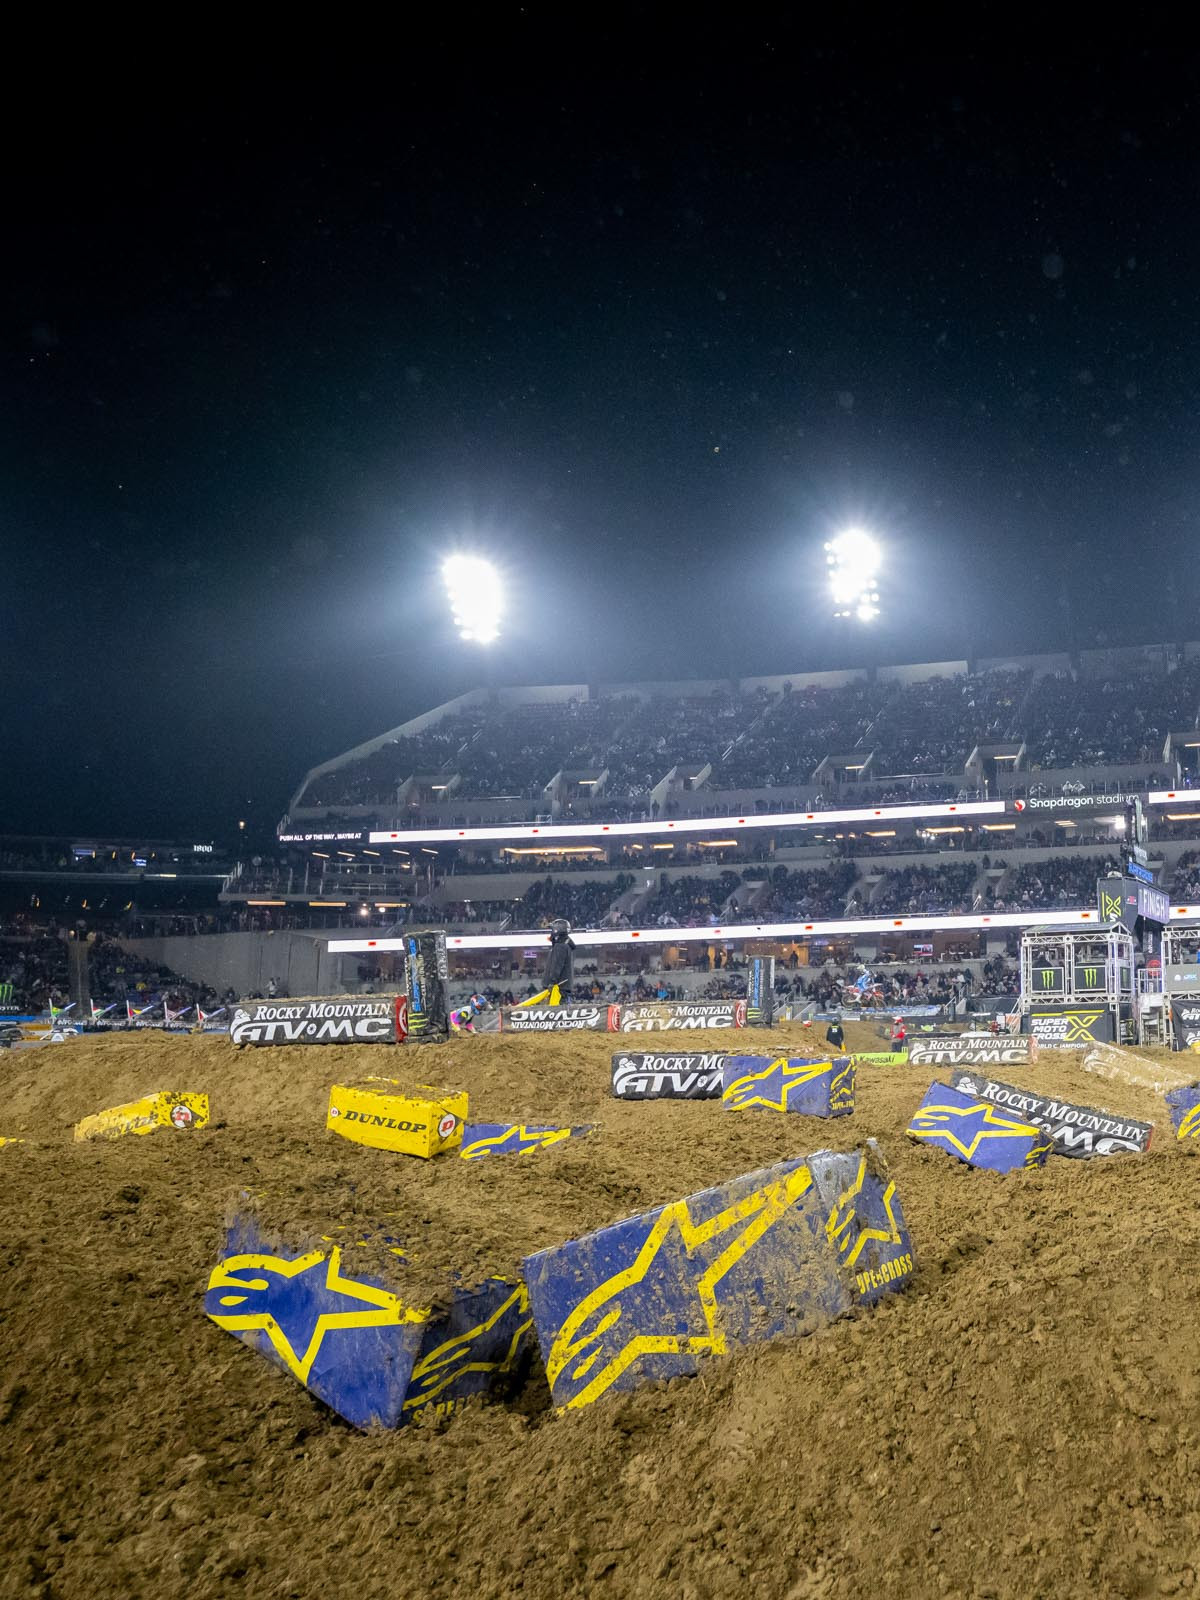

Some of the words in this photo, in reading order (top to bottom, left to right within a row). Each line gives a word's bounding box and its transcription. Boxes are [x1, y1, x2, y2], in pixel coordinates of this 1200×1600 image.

[1030, 796, 1093, 809] Snapdragon
[1096, 794, 1139, 805] stadium
[254, 1006, 306, 1021] ROCKY
[306, 1003, 391, 1019] MOUNTAIN
[676, 1006, 733, 1016] MOUNTAIN
[1031, 1018, 1069, 1026] SUPER
[928, 1040, 966, 1050] ROCKY
[967, 1039, 1028, 1049] MOUNTAIN
[640, 1056, 694, 1072] ROCKY
[981, 1082, 1046, 1114] ROCKY
[1044, 1102, 1148, 1141] MOUNTAIN
[344, 1110, 427, 1133] DUNLOP
